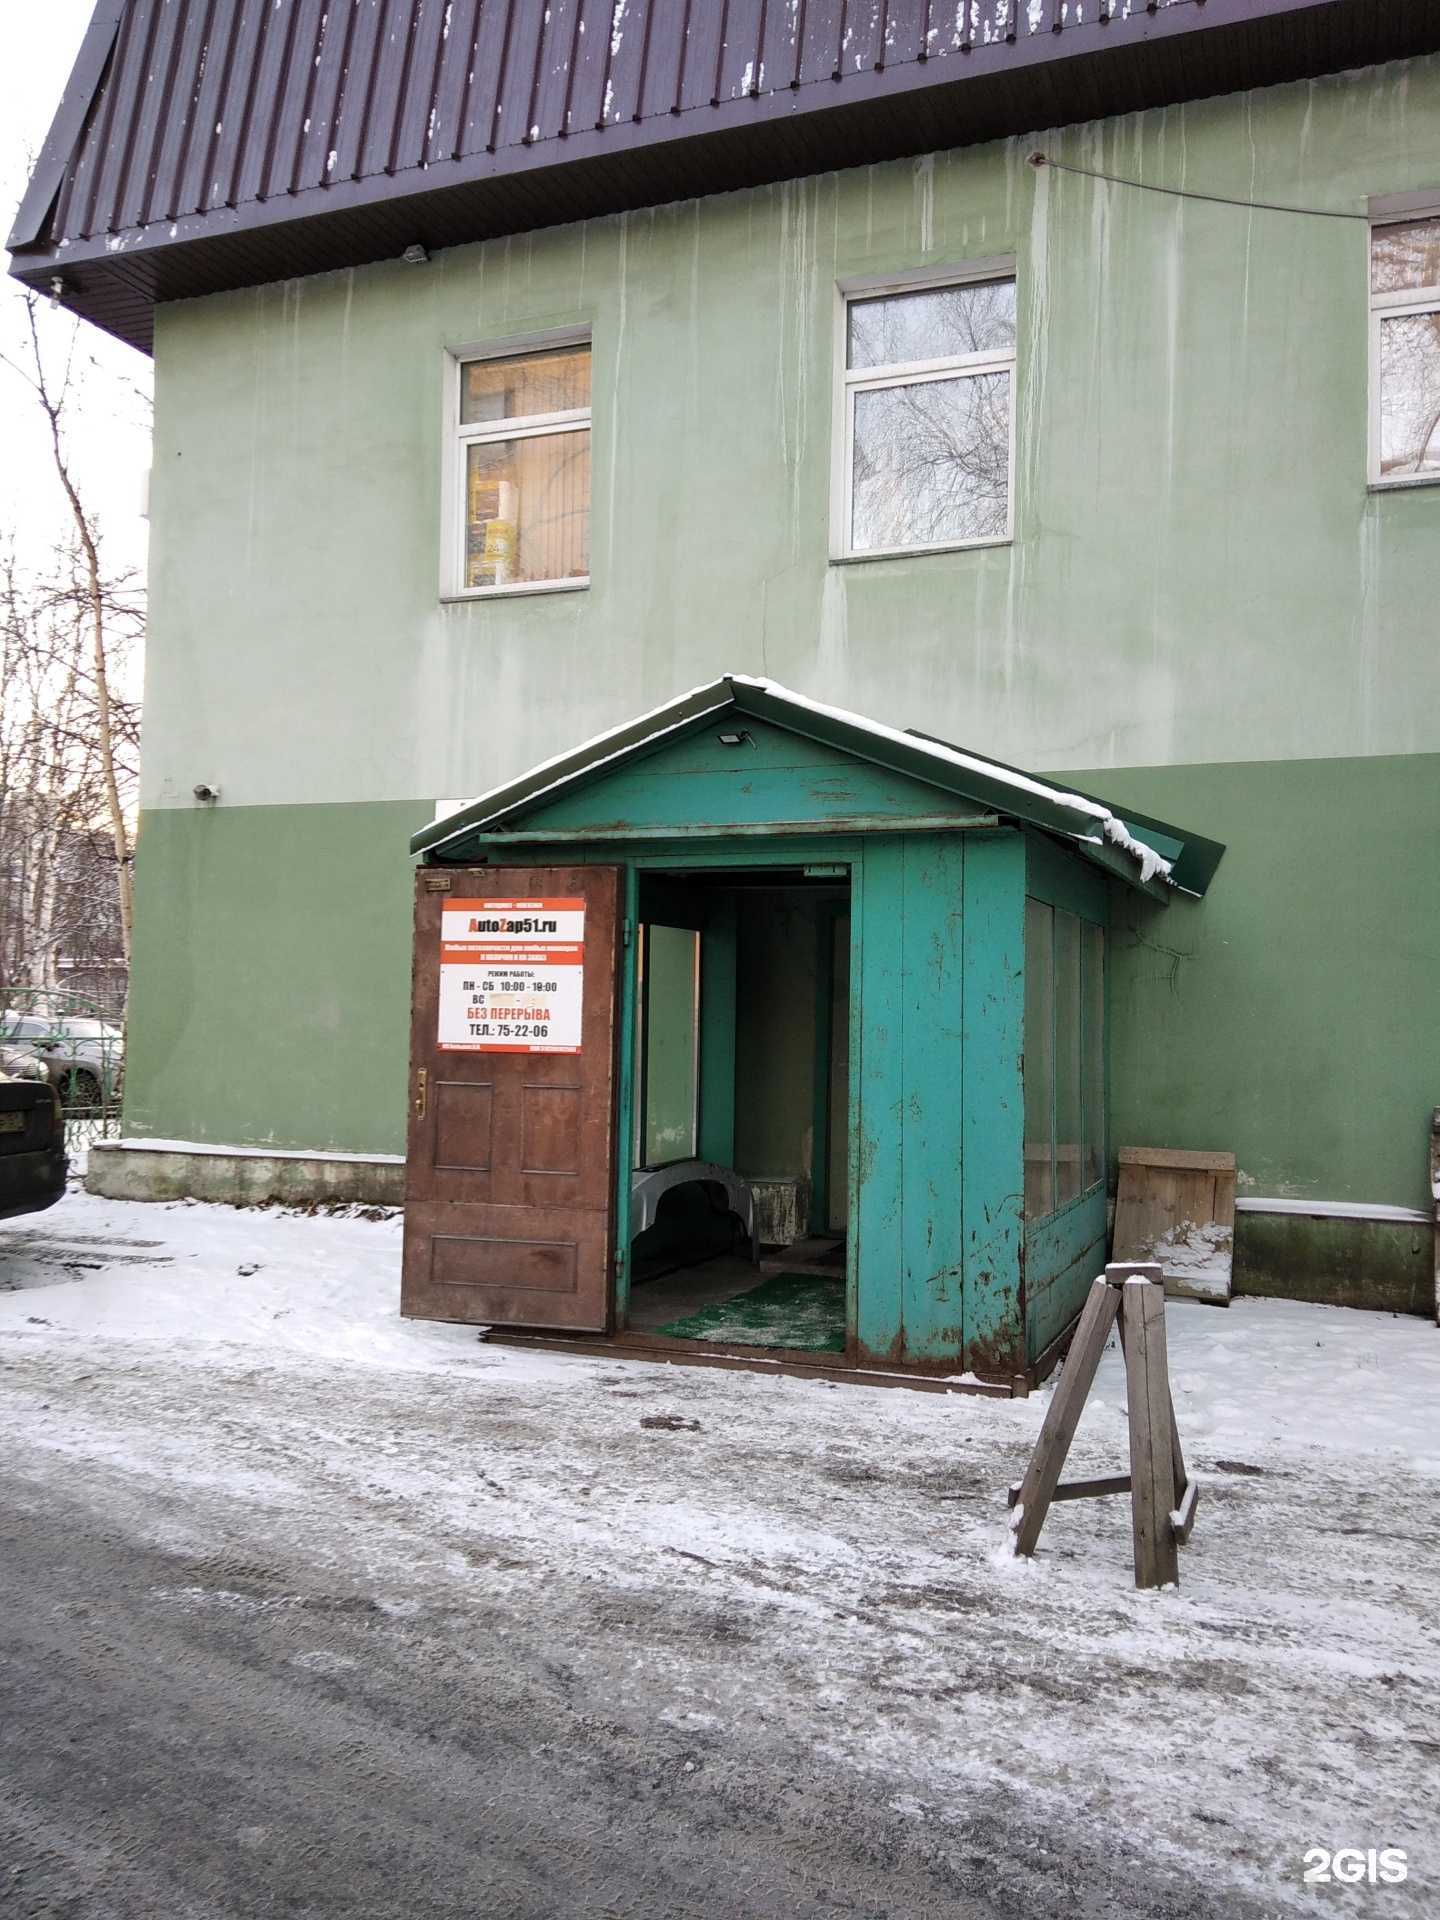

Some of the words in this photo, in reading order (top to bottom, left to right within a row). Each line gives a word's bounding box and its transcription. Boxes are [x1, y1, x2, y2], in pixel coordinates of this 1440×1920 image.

[468, 918, 557, 934] AutoZap51.ru
[463, 981, 475, 991] ПН
[482, 981, 495, 991] СБ
[500, 981, 525, 992] 10:00
[472, 994, 485, 1005] ВС
[467, 1007, 487, 1019] БЕЗ
[490, 1007, 551, 1021] ПЕРЕРЫВА
[497, 1024, 548, 1037] 75-22-06
